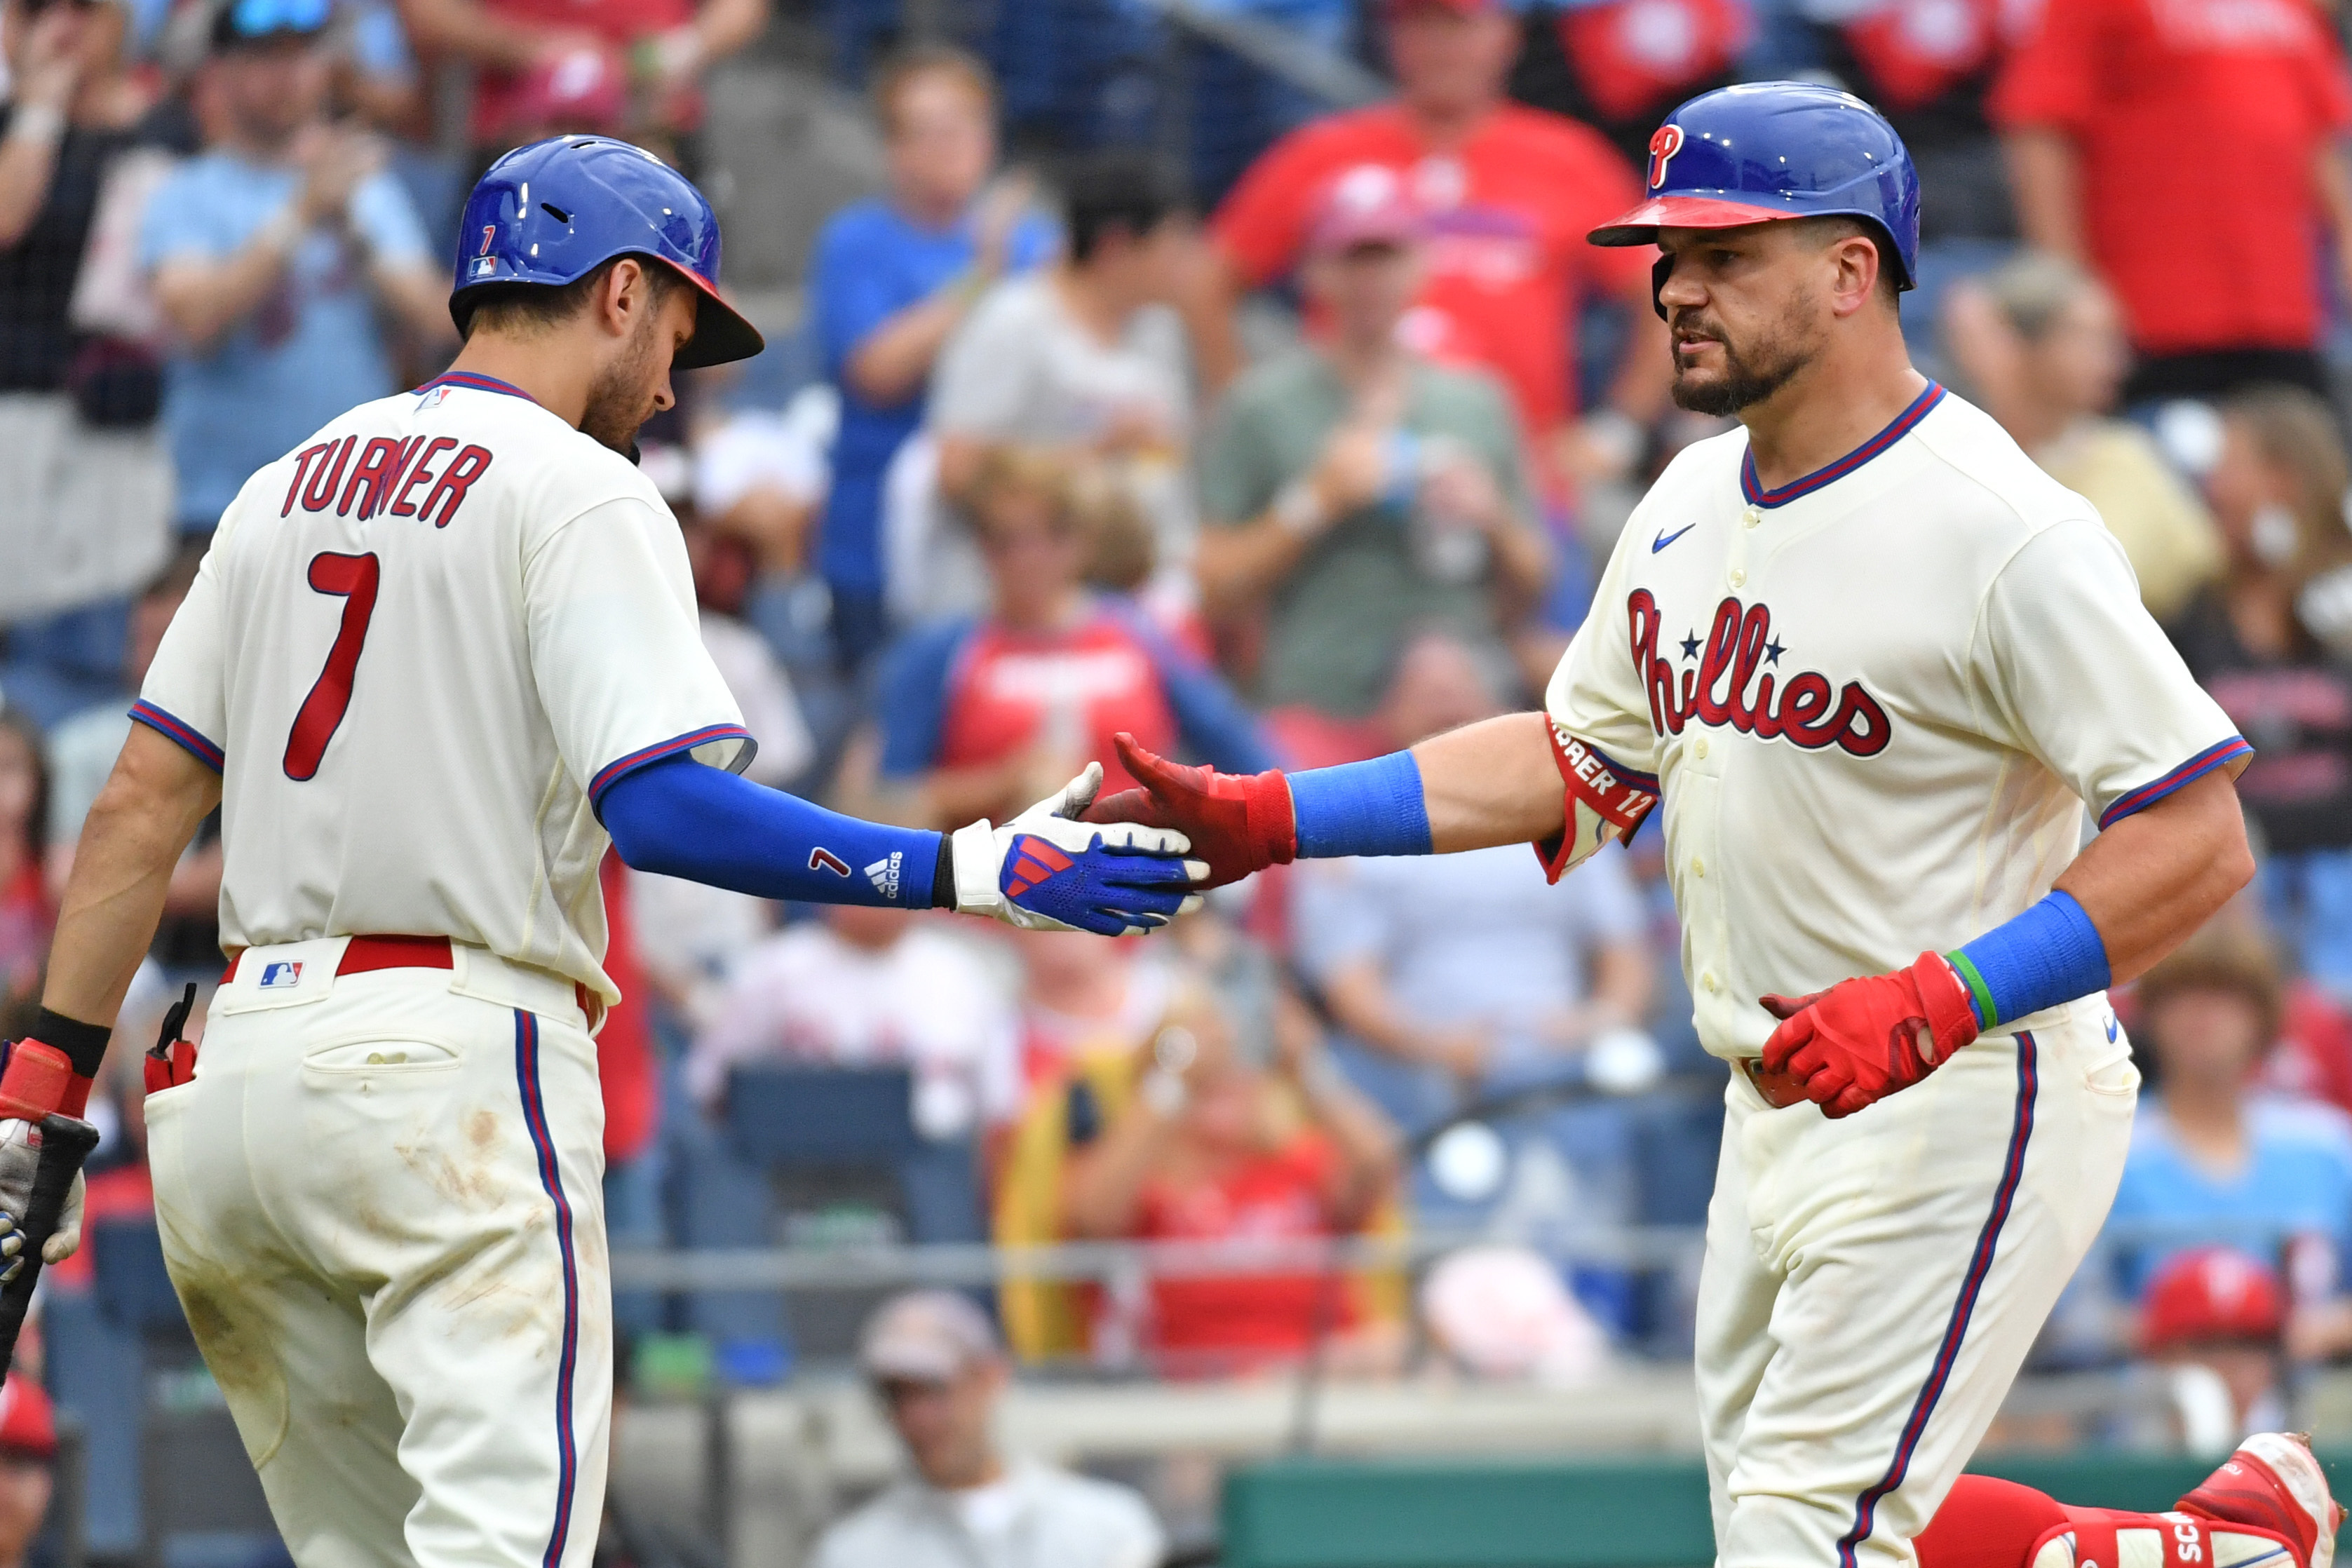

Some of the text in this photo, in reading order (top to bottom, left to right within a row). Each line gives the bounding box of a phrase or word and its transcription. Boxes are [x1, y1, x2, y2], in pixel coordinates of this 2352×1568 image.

[480, 225, 496, 255] 7
[281, 435, 494, 529] TURNER
[283, 551, 380, 781] 7
[1628, 588, 1891, 757] Phillies
[1616, 790, 1653, 818] 12
[808, 846, 851, 877] 7
[885, 851, 903, 898] adidas
